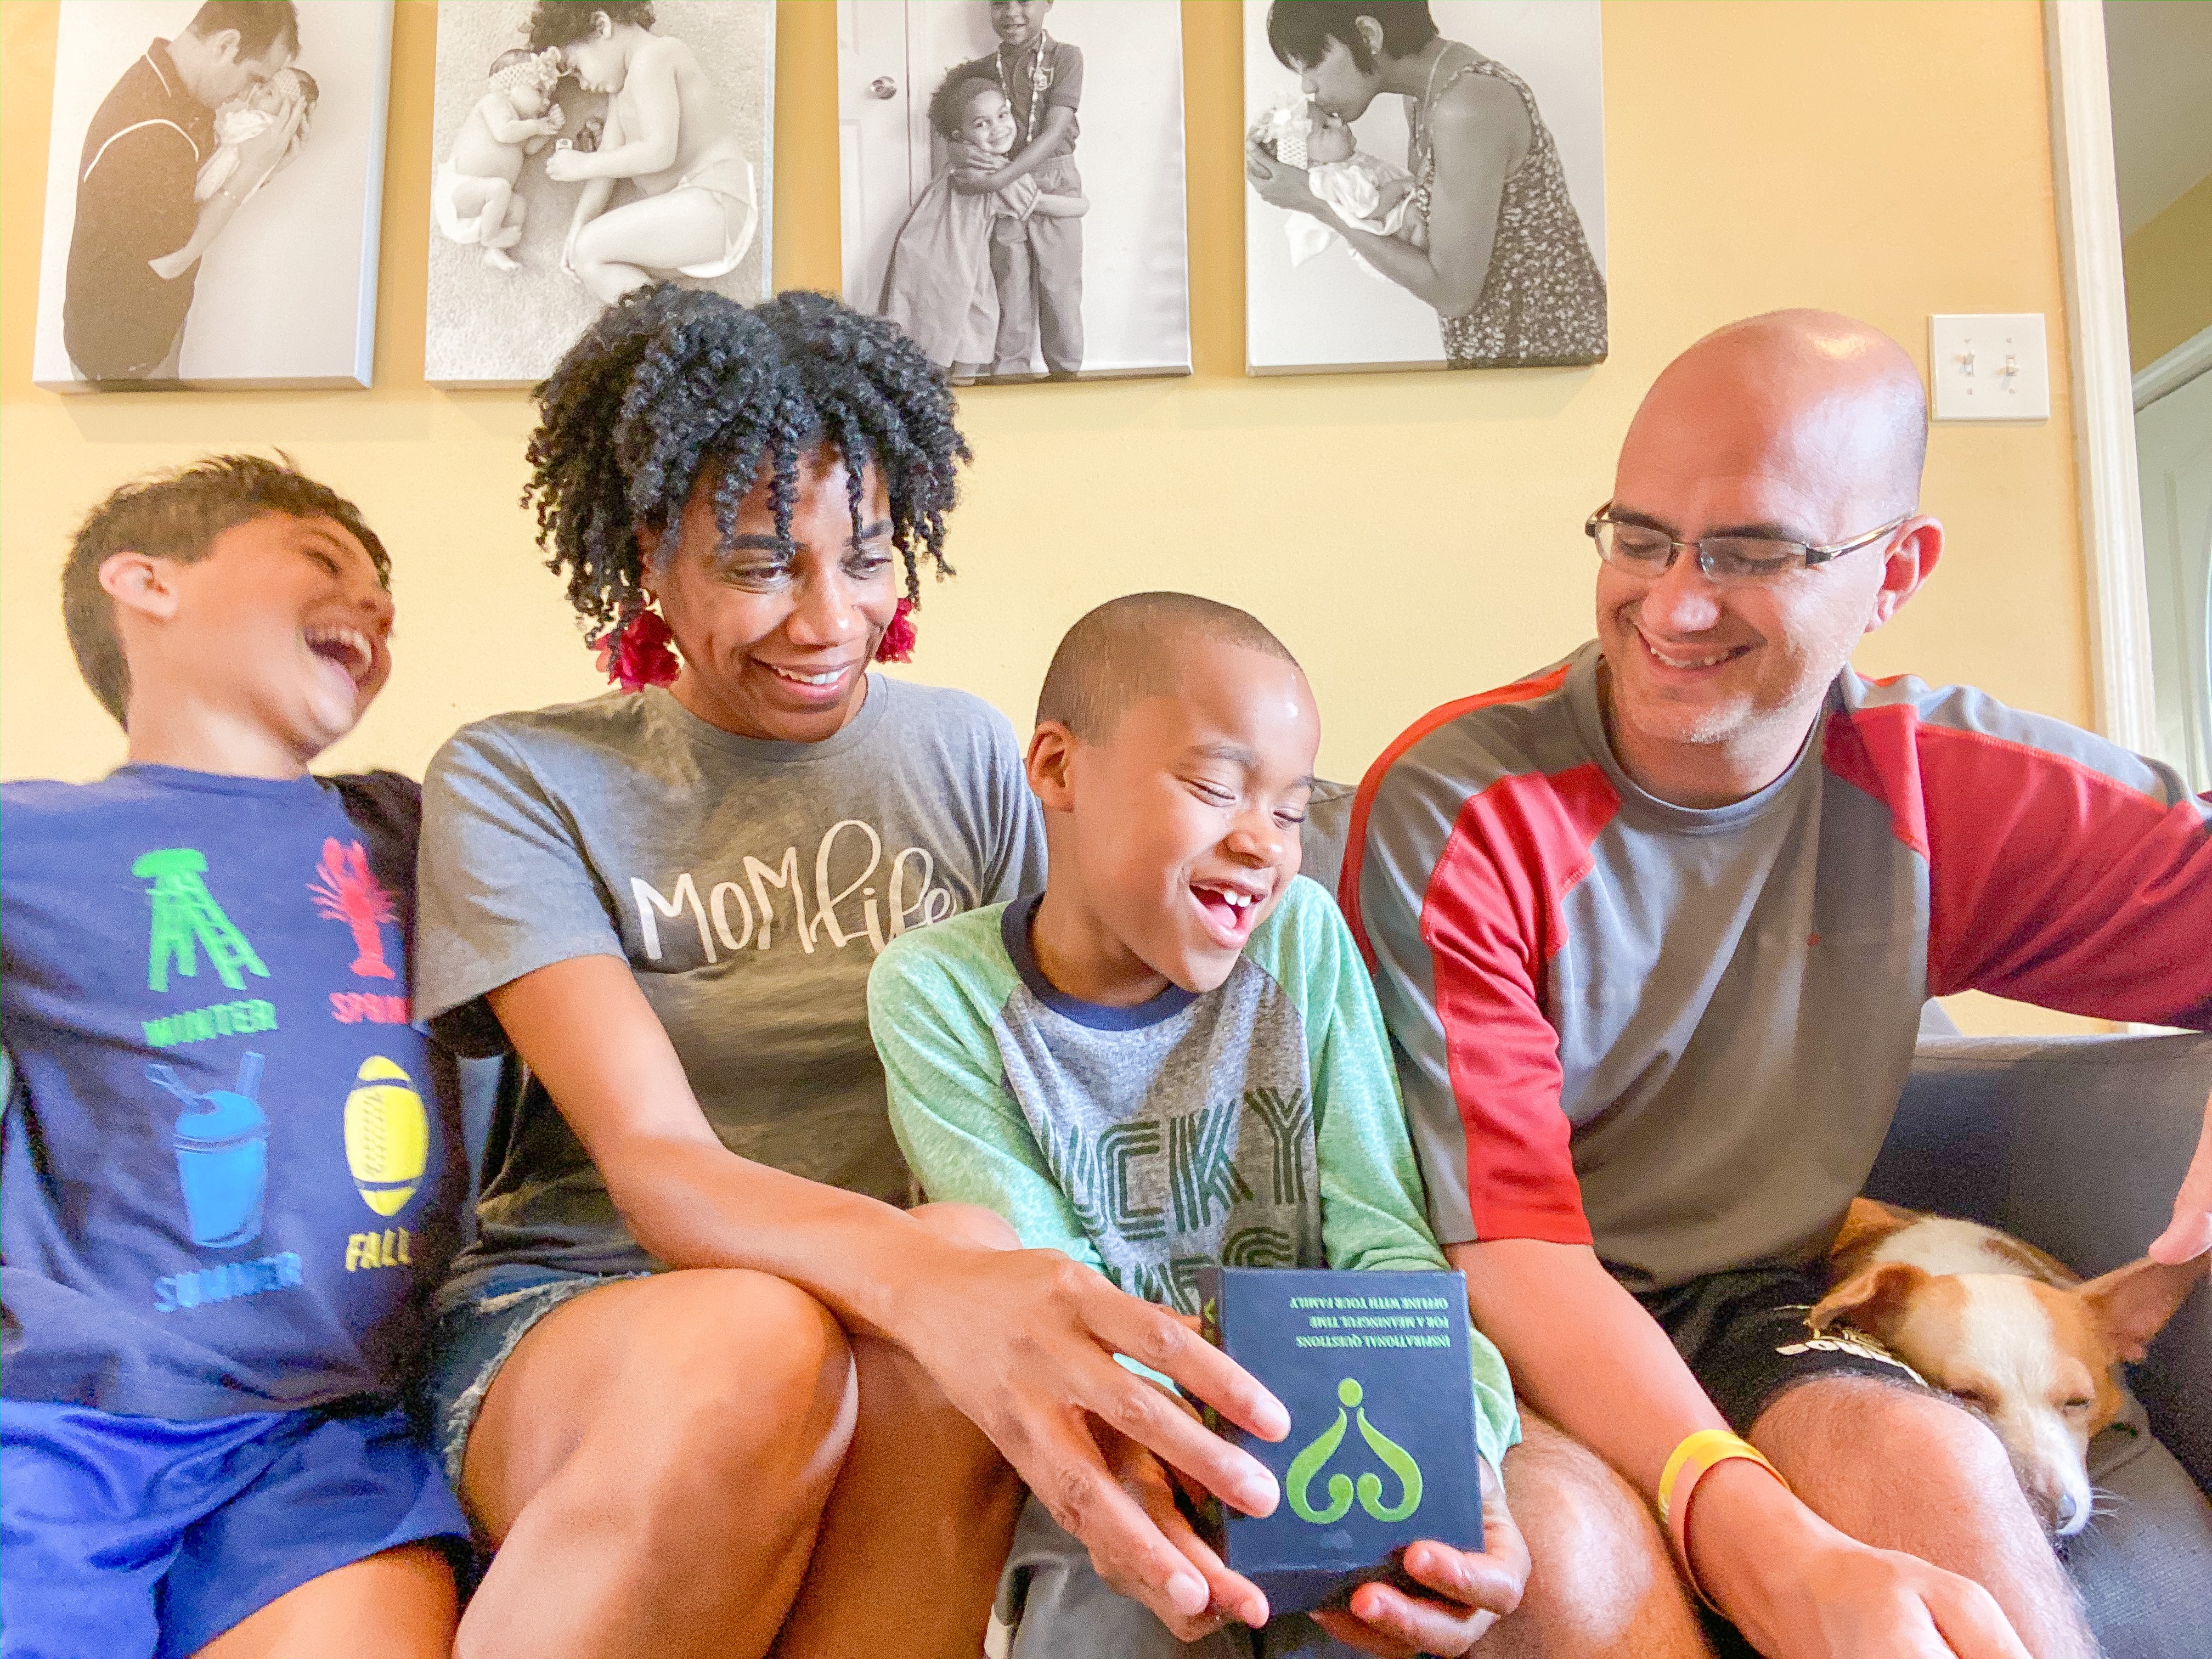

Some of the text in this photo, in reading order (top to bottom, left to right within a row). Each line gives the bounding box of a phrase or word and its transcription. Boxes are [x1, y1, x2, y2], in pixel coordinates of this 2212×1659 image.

[1039, 1088, 1310, 1242] UCKY
[346, 1226, 411, 1273] FALL
[1290, 1296, 1448, 1310] OFFLINE WITH YOUR FAMILY
[1309, 1316, 1449, 1329] FOR A MEANINGFUL TIME
[1296, 1333, 1451, 1348] INSPIRATIONAL QUESTIONS
